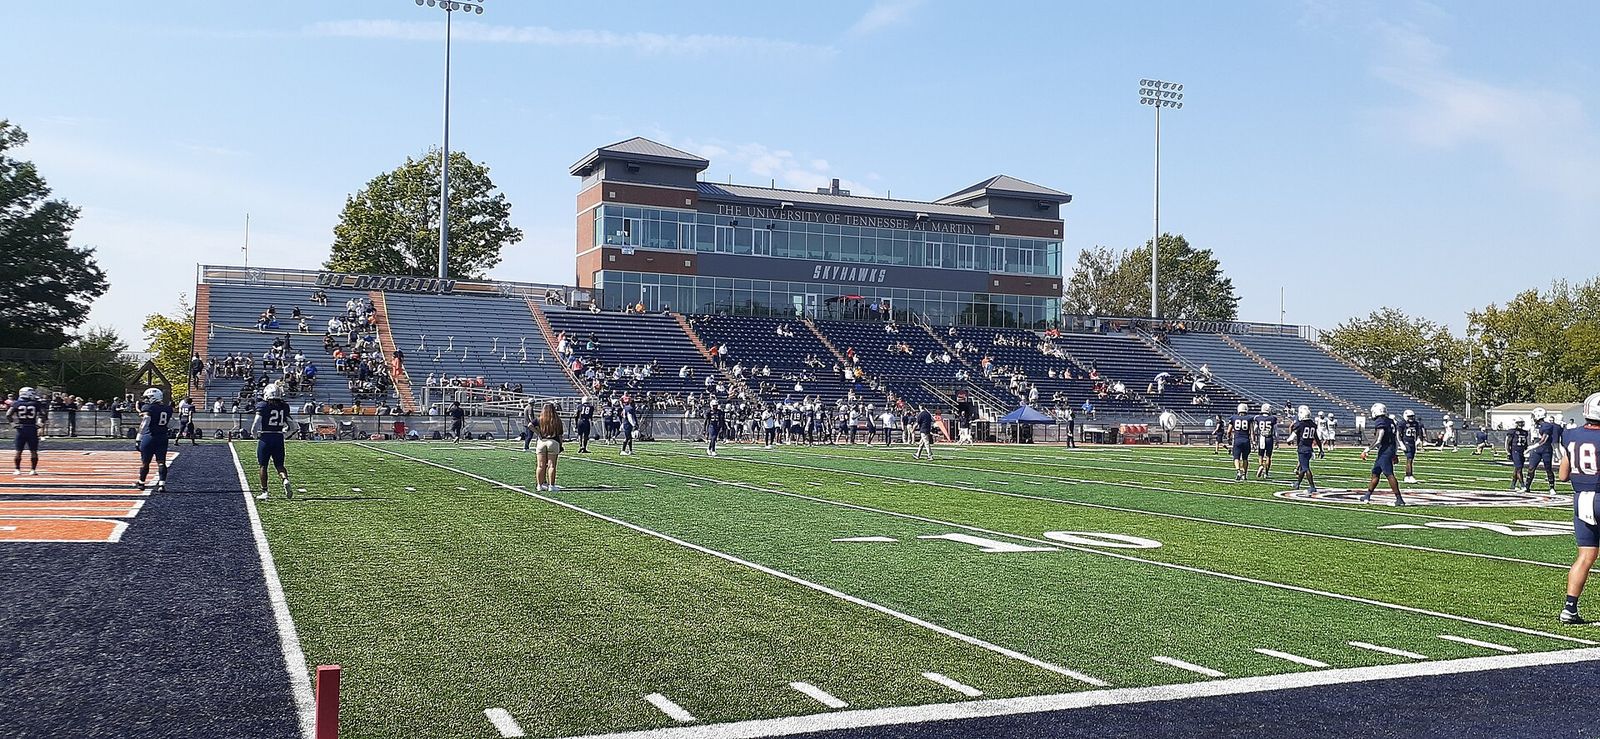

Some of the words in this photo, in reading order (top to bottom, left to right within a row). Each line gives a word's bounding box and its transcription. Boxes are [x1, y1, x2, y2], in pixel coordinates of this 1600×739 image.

[717, 204, 742, 216] THE
[747, 207, 821, 222] UNIVERSITY
[825, 213, 840, 224] OF
[845, 215, 909, 229] TENNESSEE
[914, 221, 928, 231] AT
[932, 222, 975, 234] MARTIN
[813, 265, 886, 283] SKYHAWKS
[314, 272, 348, 287] UT
[353, 274, 456, 293] MARTIN
[17, 405, 36, 419] 23
[268, 409, 285, 426] 21
[581, 406, 591, 415] 18
[158, 411, 168, 426] 8
[1234, 419, 1249, 431] 88
[1259, 421, 1272, 431] 85
[1302, 426, 1316, 439] 80
[1568, 441, 1597, 475] 18
